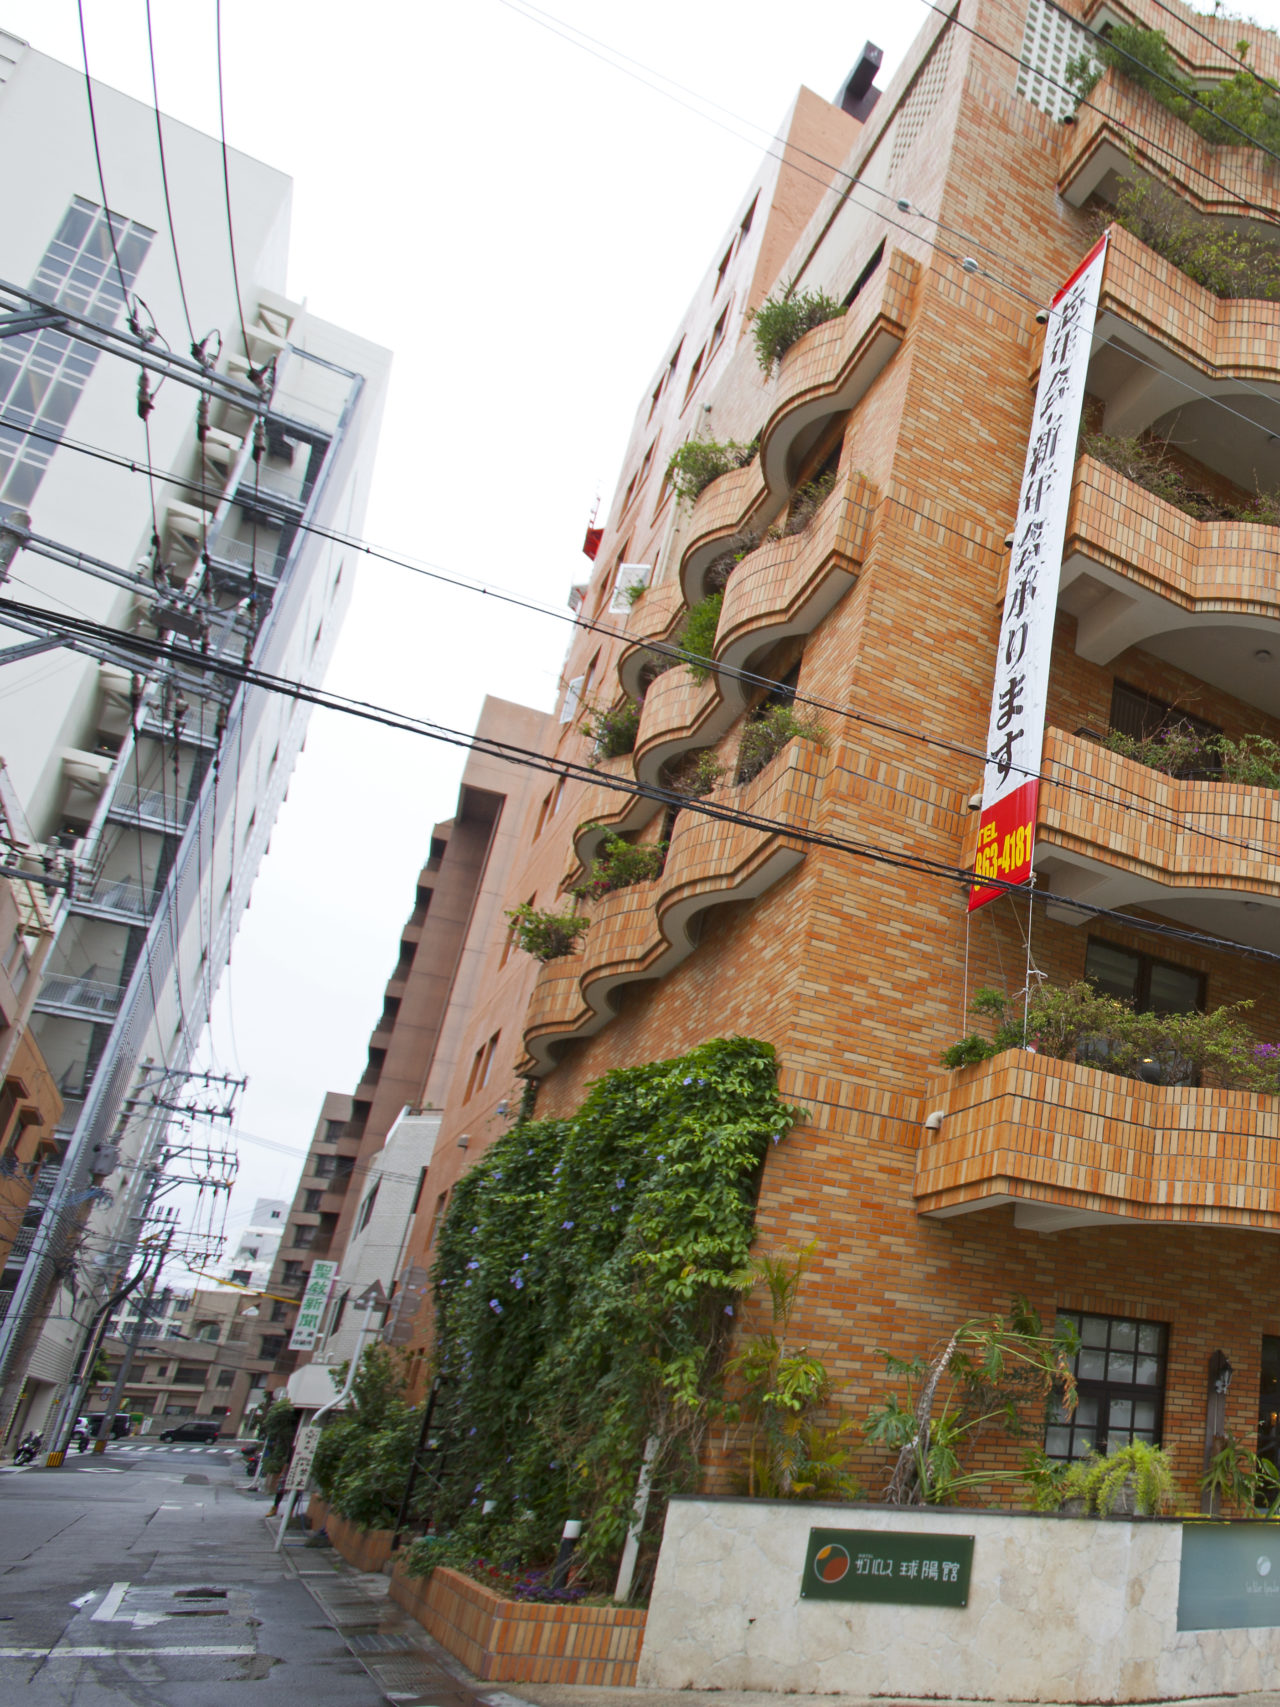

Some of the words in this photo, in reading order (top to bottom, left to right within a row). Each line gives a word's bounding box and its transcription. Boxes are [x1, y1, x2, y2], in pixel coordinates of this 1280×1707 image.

[977, 821, 998, 849] TEL
[899, 1559, 960, 1582] 球陽館
